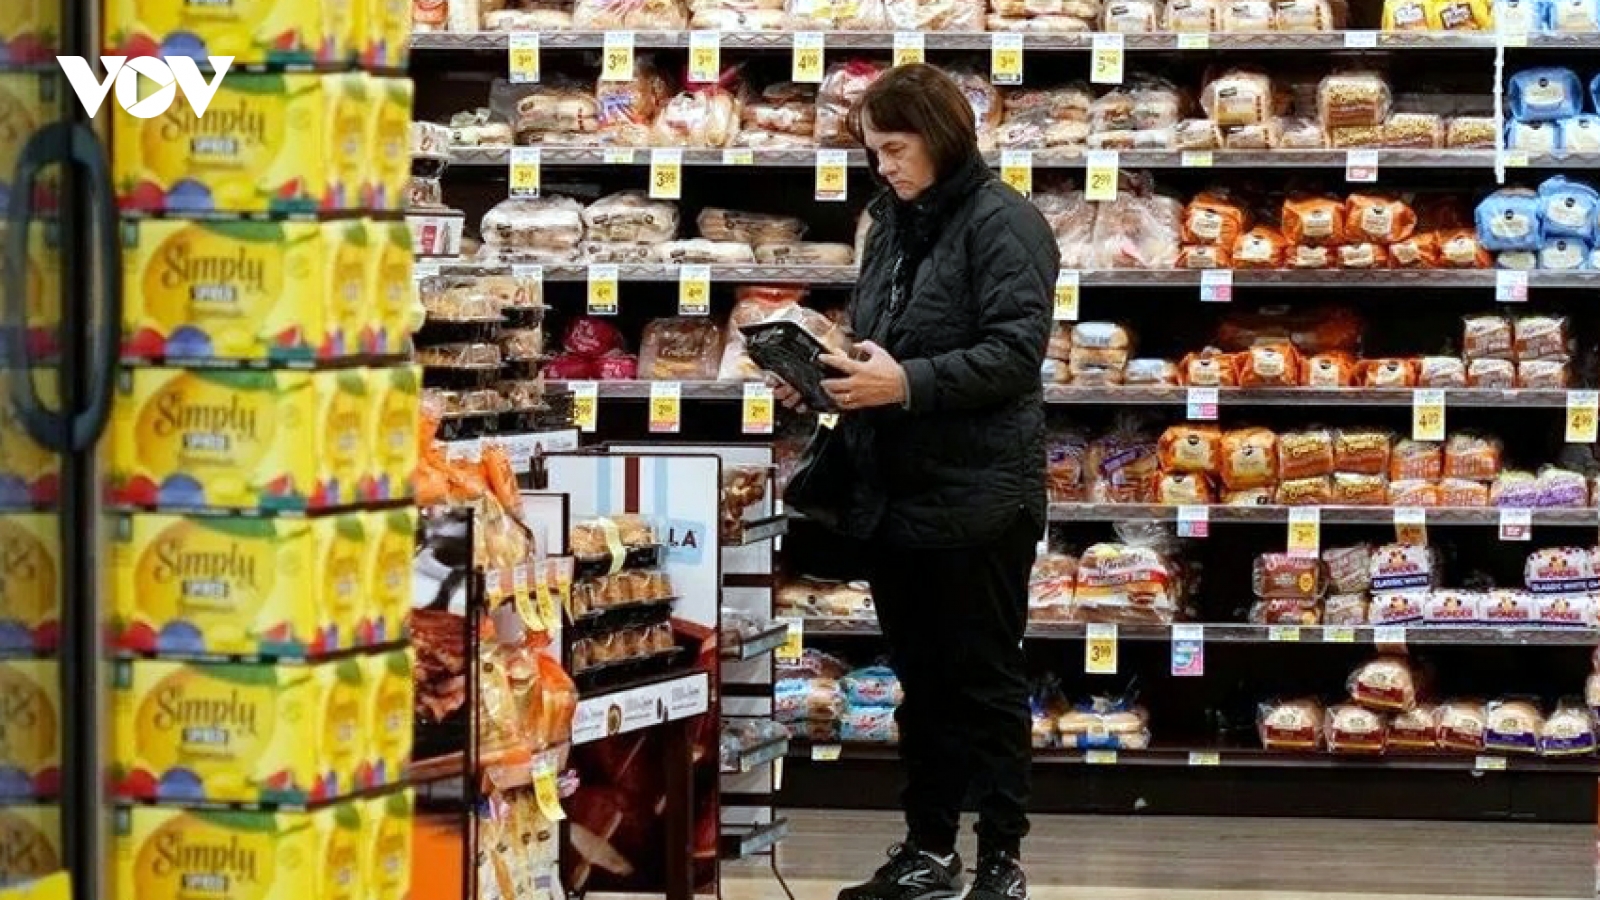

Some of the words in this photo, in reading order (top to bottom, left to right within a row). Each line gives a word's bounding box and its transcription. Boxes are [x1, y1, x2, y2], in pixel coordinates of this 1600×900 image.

[161, 242, 268, 295] Simply
[153, 391, 260, 442] Simply
[153, 538, 260, 591] Simply
[153, 687, 259, 738] Simply
[151, 832, 259, 883] Simply
